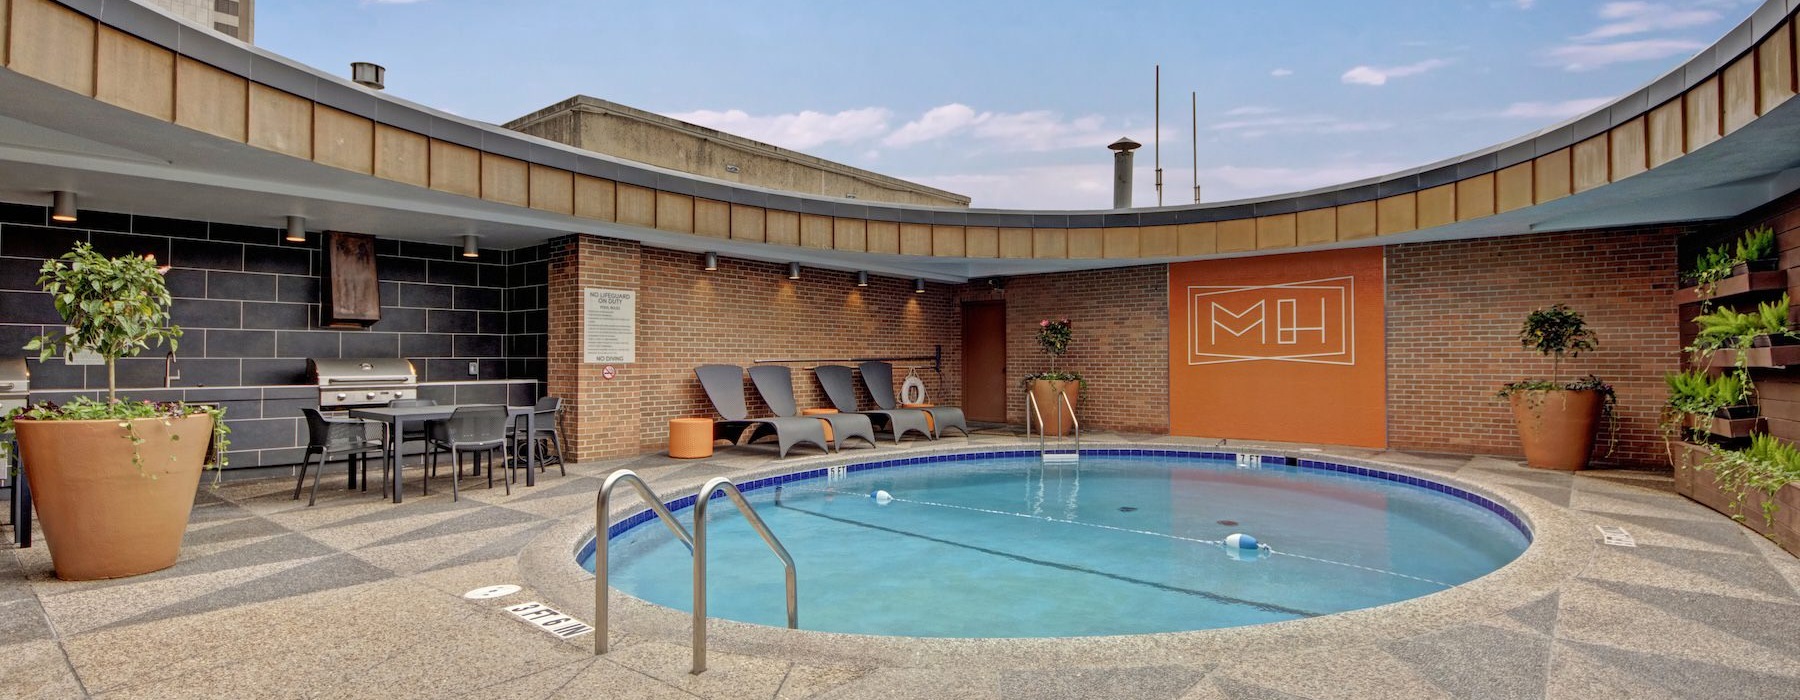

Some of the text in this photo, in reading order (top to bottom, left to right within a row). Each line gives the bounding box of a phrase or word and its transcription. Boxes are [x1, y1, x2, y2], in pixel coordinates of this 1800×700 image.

[600, 292, 631, 300] LIFEGUARD
[511, 603, 594, 637] 3 FT 6 IN
